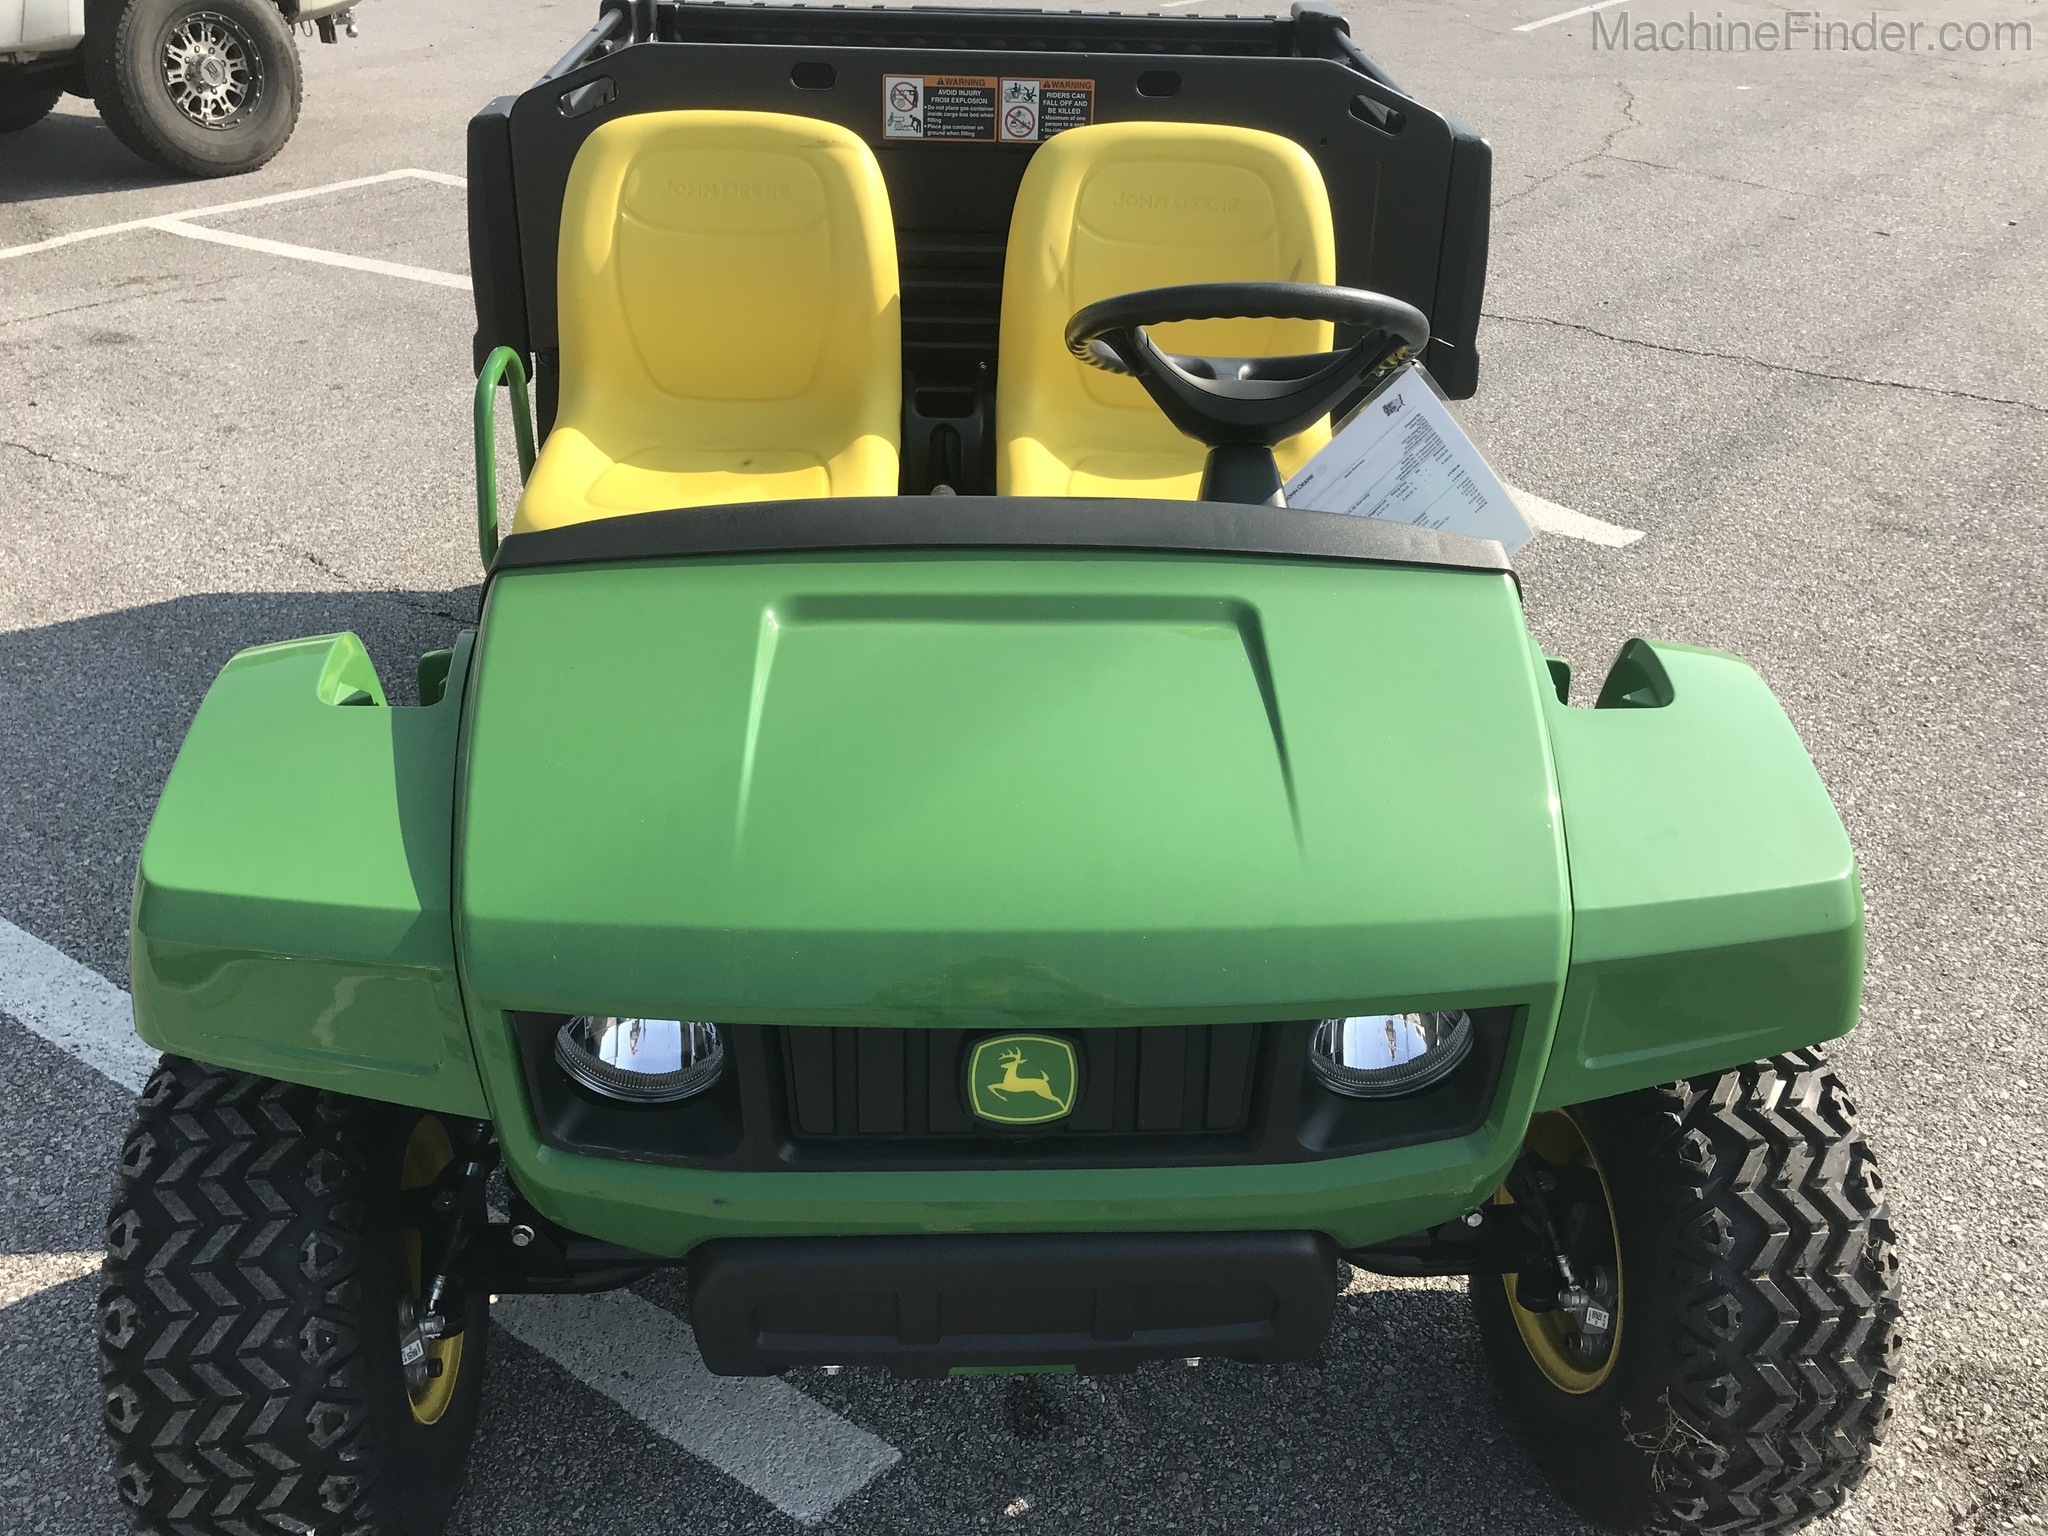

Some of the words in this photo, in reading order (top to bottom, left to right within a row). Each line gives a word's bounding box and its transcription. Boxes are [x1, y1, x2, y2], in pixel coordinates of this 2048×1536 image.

[945, 78, 985, 86] WARNING
[1051, 81, 1091, 89] WARNING
[660, 179, 717, 198] JOHN
[720, 182, 790, 200] DEERE
[1112, 191, 1168, 210] JOHN
[1173, 193, 1240, 212] DEERE
[1297, 474, 1315, 490] DEERE
